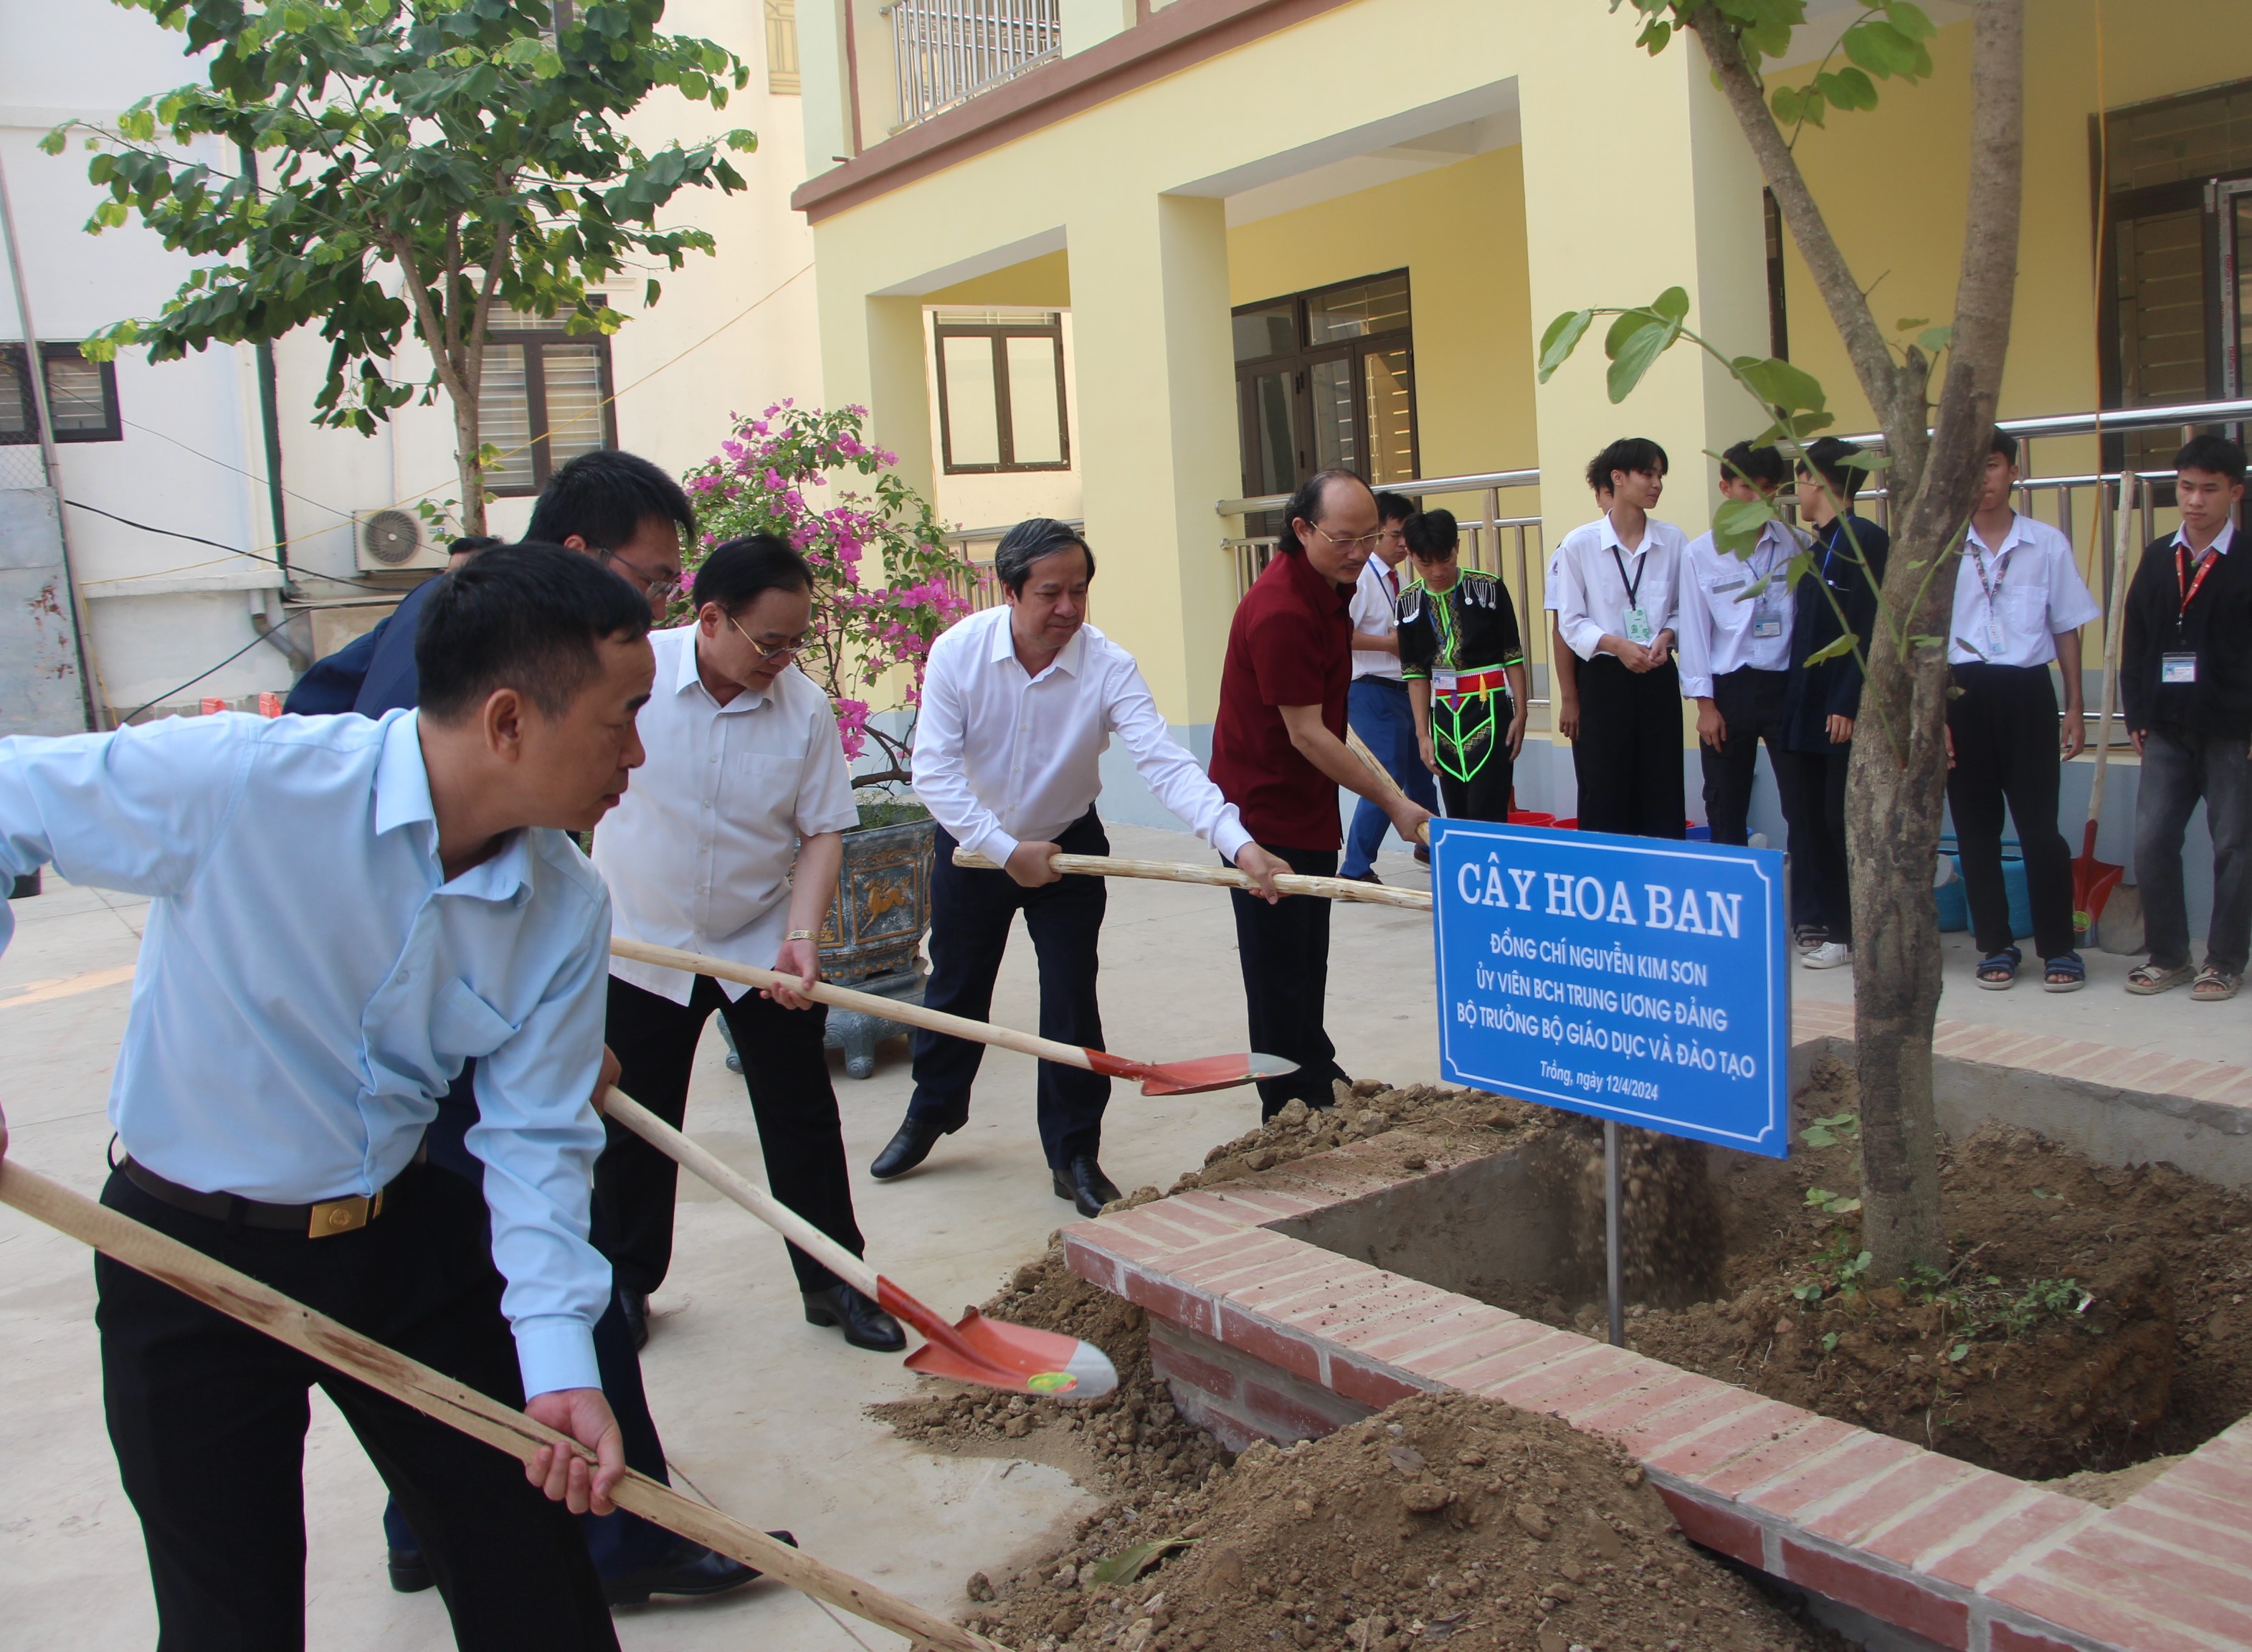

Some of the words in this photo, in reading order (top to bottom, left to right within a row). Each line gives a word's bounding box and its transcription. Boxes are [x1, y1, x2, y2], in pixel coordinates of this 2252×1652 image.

[1458, 851, 1536, 911] CÂY
[1544, 872, 1638, 926] HOA
[1644, 883, 1744, 939] BAN
[1490, 926, 1537, 960] ĐỒNG
[1539, 937, 1567, 964] CHÍ
[1569, 941, 1635, 976] NGUYỄN
[1638, 955, 1668, 981] KIM
[1671, 960, 1708, 987] SƠN
[1476, 961, 1495, 990] ỦY
[1497, 969, 1531, 997] VIÊN
[1534, 978, 1564, 1003] BCH
[1567, 984, 1618, 1012] TRUNG
[1621, 992, 1672, 1022] ƯƠNG
[1673, 996, 1729, 1032] ĐẢNG
[1457, 999, 1478, 1029] BỘ
[1479, 1003, 1539, 1037] TRƯỞNG
[1541, 1015, 1564, 1045] BỘ
[1566, 1020, 1608, 1050] GIÁO
[1612, 1030, 1645, 1060] DỤC
[1648, 1033, 1673, 1063] VÀ
[1676, 1038, 1716, 1071] ĐÀO
[1719, 1050, 1756, 1081] TẠO
[1540, 1059, 1573, 1086] Trồng,
[1576, 1071, 1604, 1093] ngày
[1606, 1075, 1658, 1101] 12/4/2024
